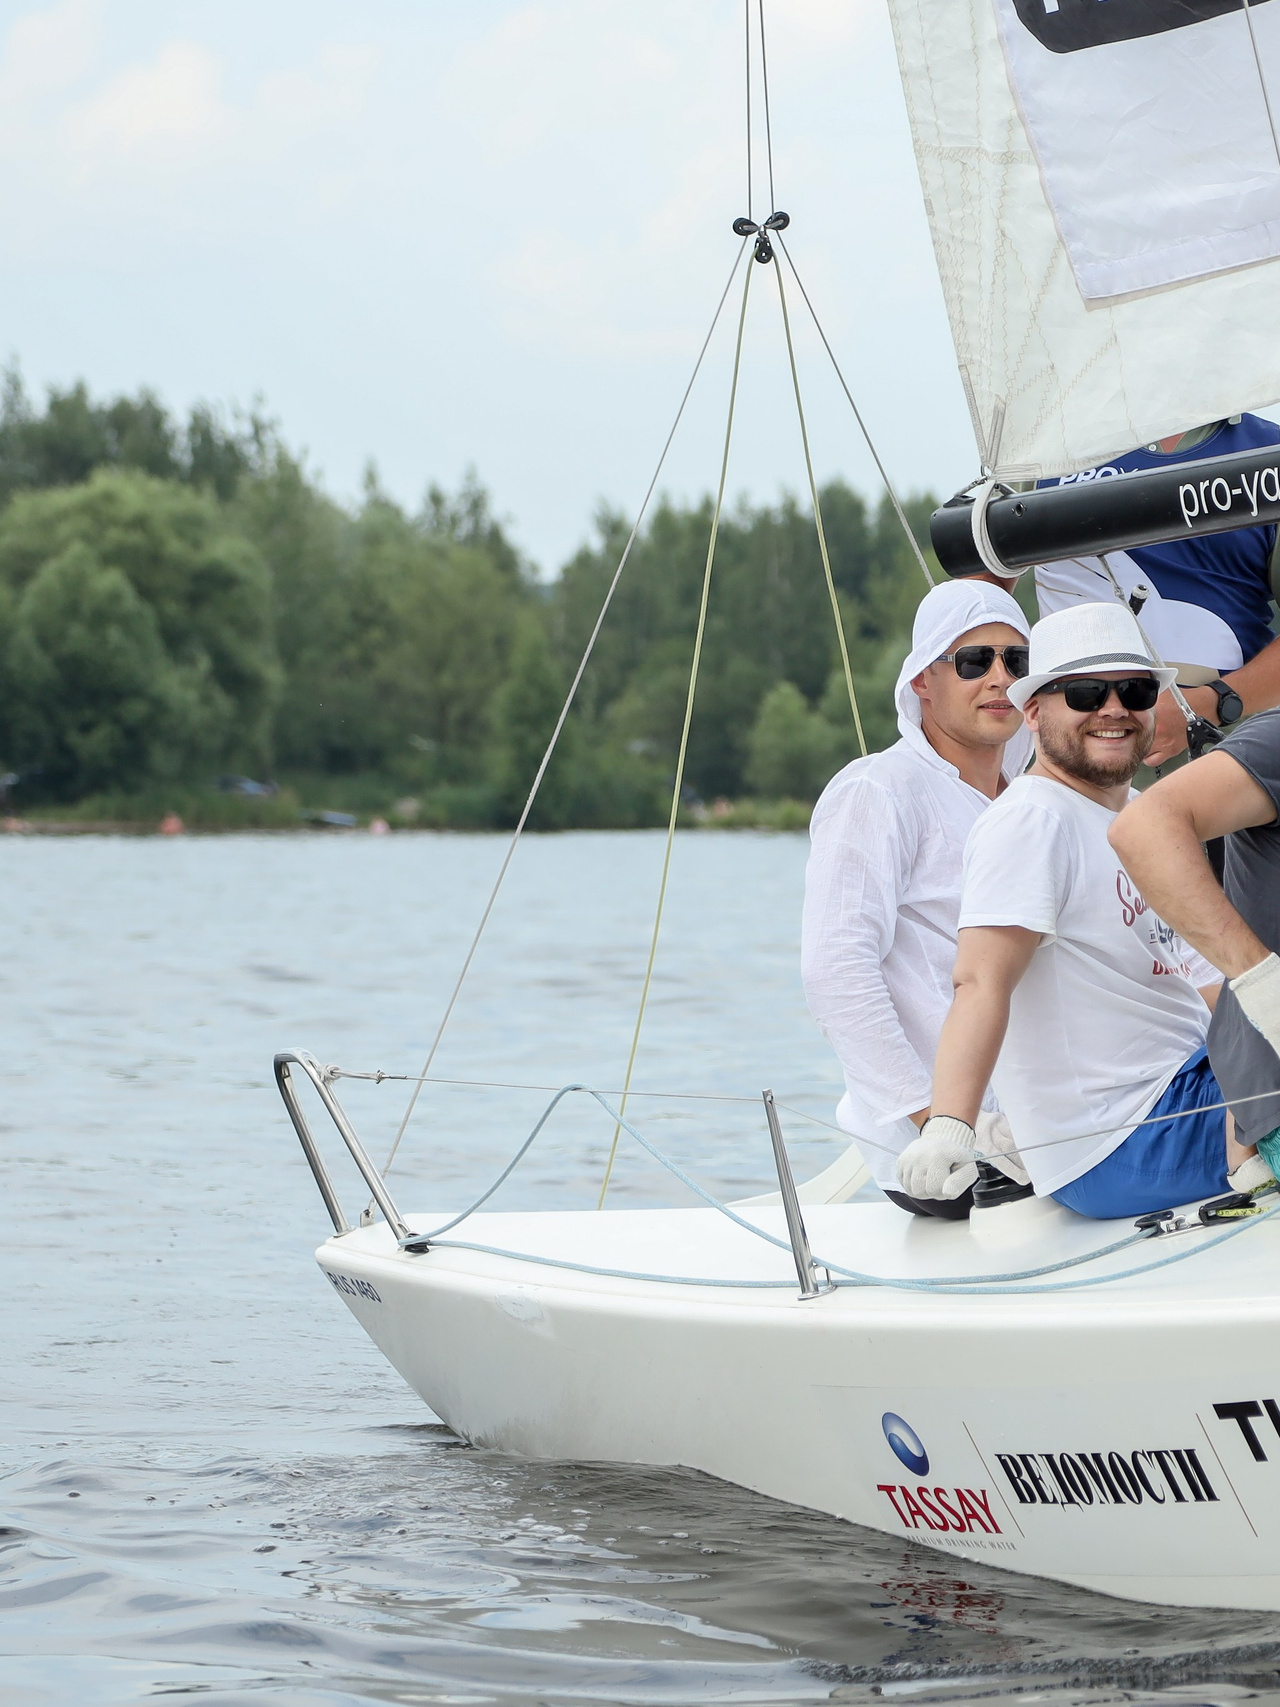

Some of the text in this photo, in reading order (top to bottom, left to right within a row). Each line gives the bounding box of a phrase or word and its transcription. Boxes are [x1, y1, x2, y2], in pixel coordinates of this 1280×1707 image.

[326, 1271, 357, 1297] RUS
[994, 1448, 1221, 1513] ВЕДОМОСТИ
[877, 1484, 1004, 1535] TASSAY
[944, 1537, 988, 1550] DRINKING
[988, 1540, 1018, 1552] WATER
